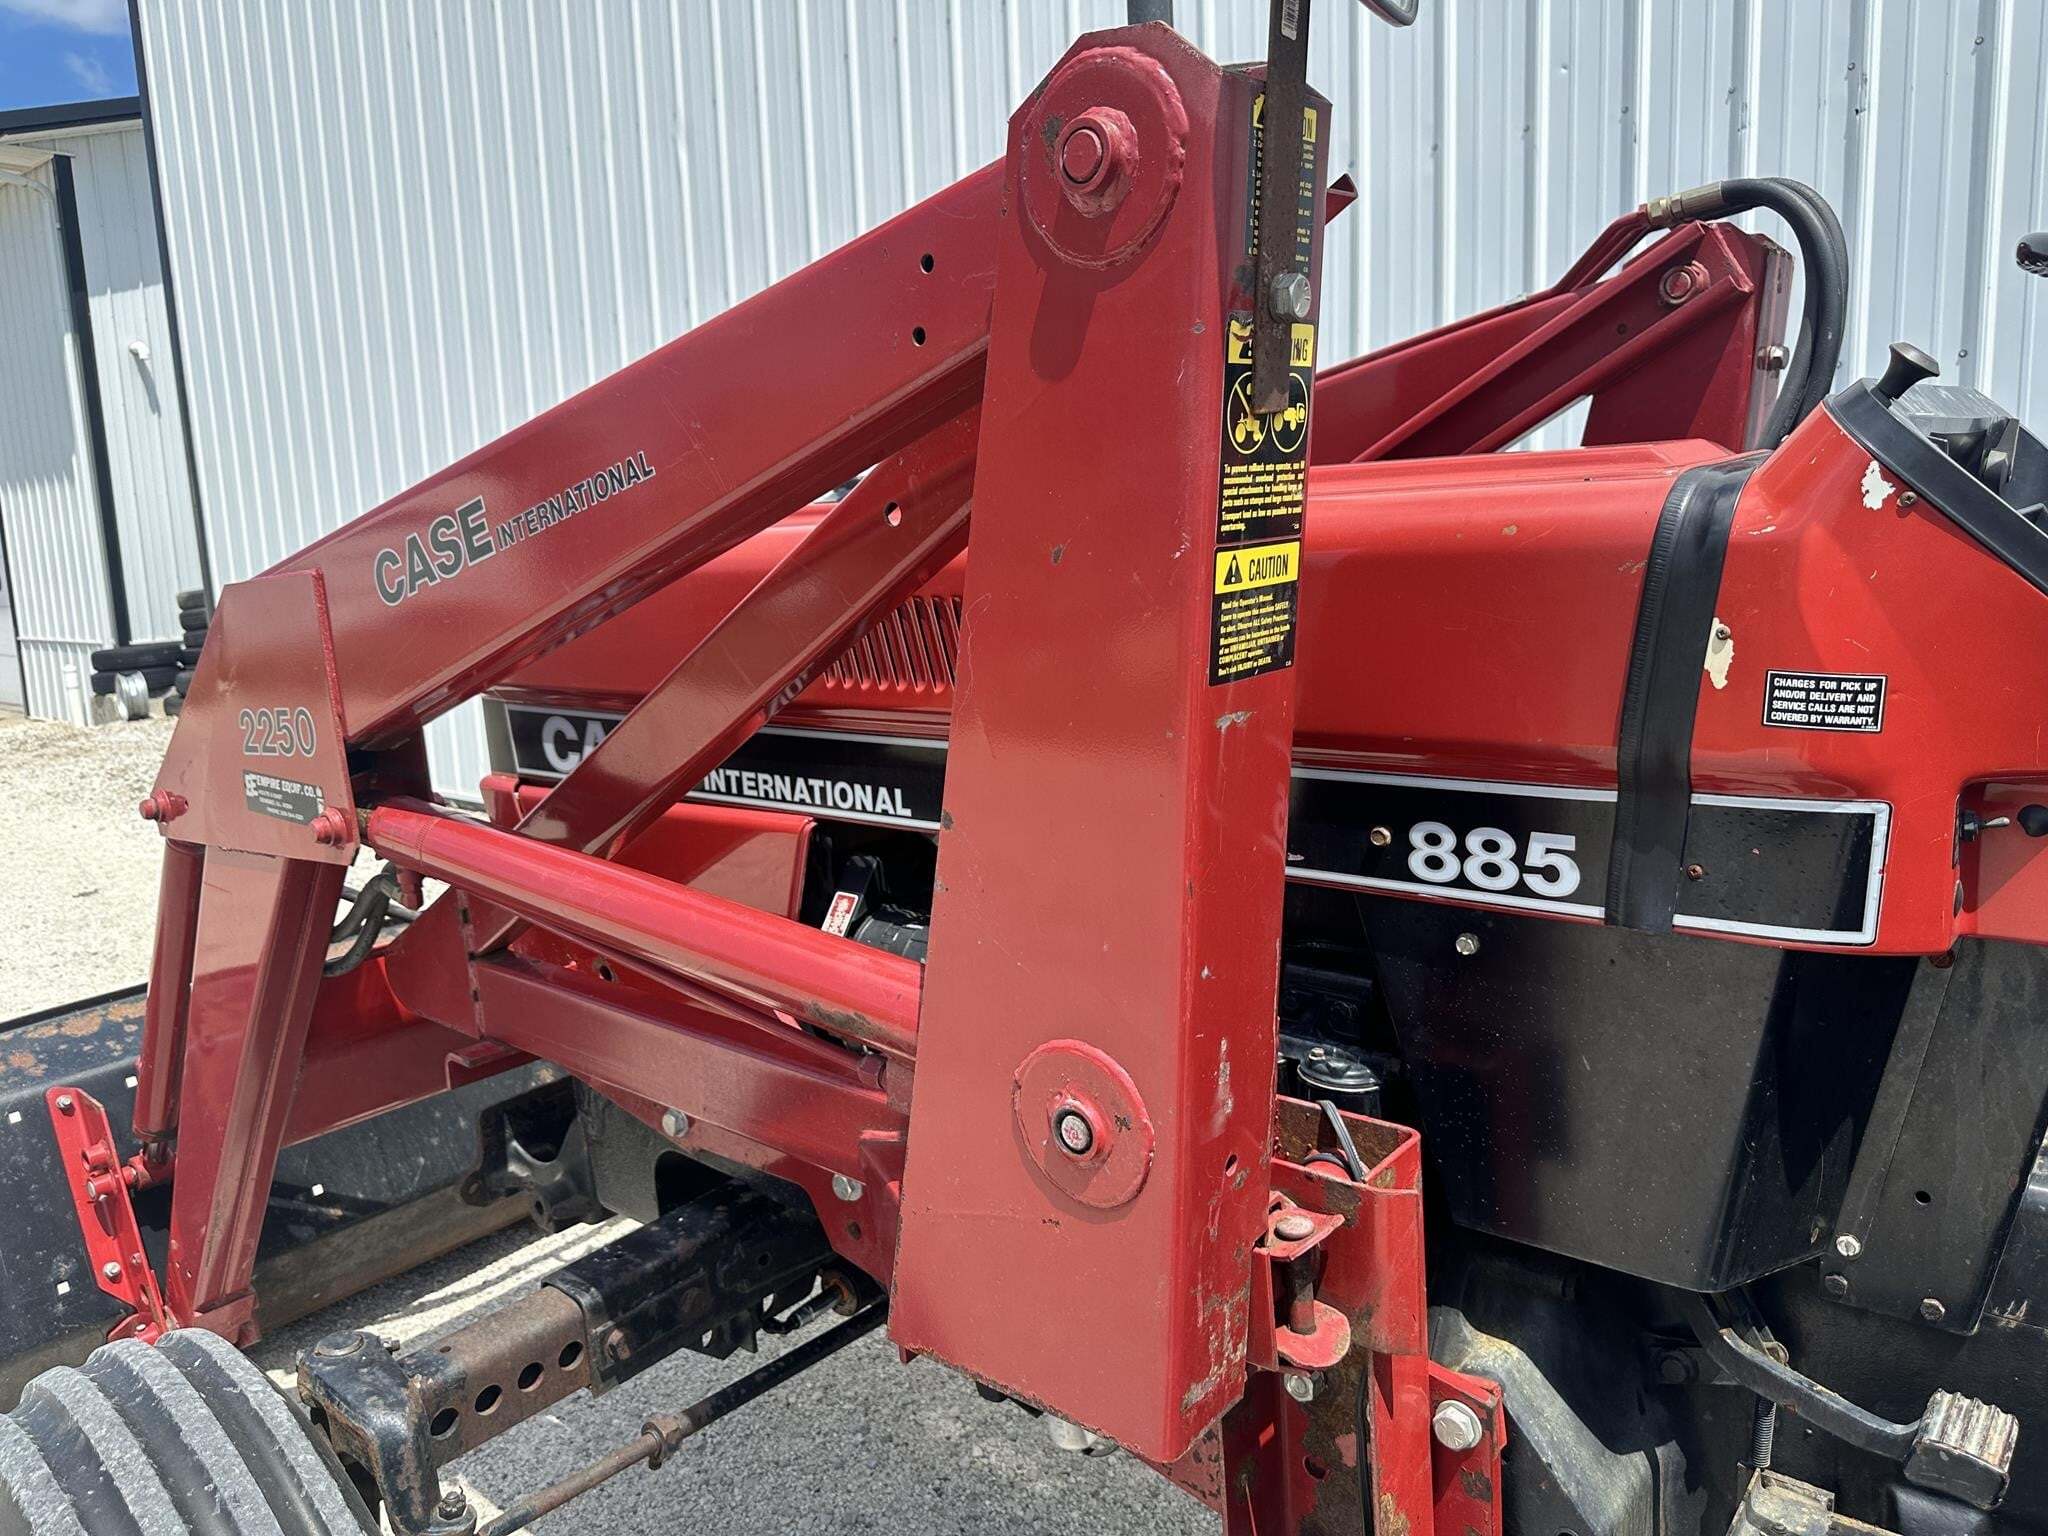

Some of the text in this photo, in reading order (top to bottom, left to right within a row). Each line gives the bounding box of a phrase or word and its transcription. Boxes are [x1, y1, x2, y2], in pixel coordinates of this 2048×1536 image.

[375, 451, 656, 606] CASE INTERNATIONAL
[1248, 554, 1289, 581] CAUTION
[1774, 678, 1877, 691] CHARGES FOR PICK UP
[1774, 689, 1875, 702] AND/OR DELIVERY AND
[1771, 712, 1808, 722] COVERED
[1810, 715, 1822, 723] BY
[1825, 716, 1874, 727] WARRANTY.
[1773, 700, 1875, 714] SERVICE CALLS ARE NOT
[239, 706, 316, 757] 2250
[704, 768, 912, 817] INTERNATIONAL
[1408, 821, 1581, 898] 885
